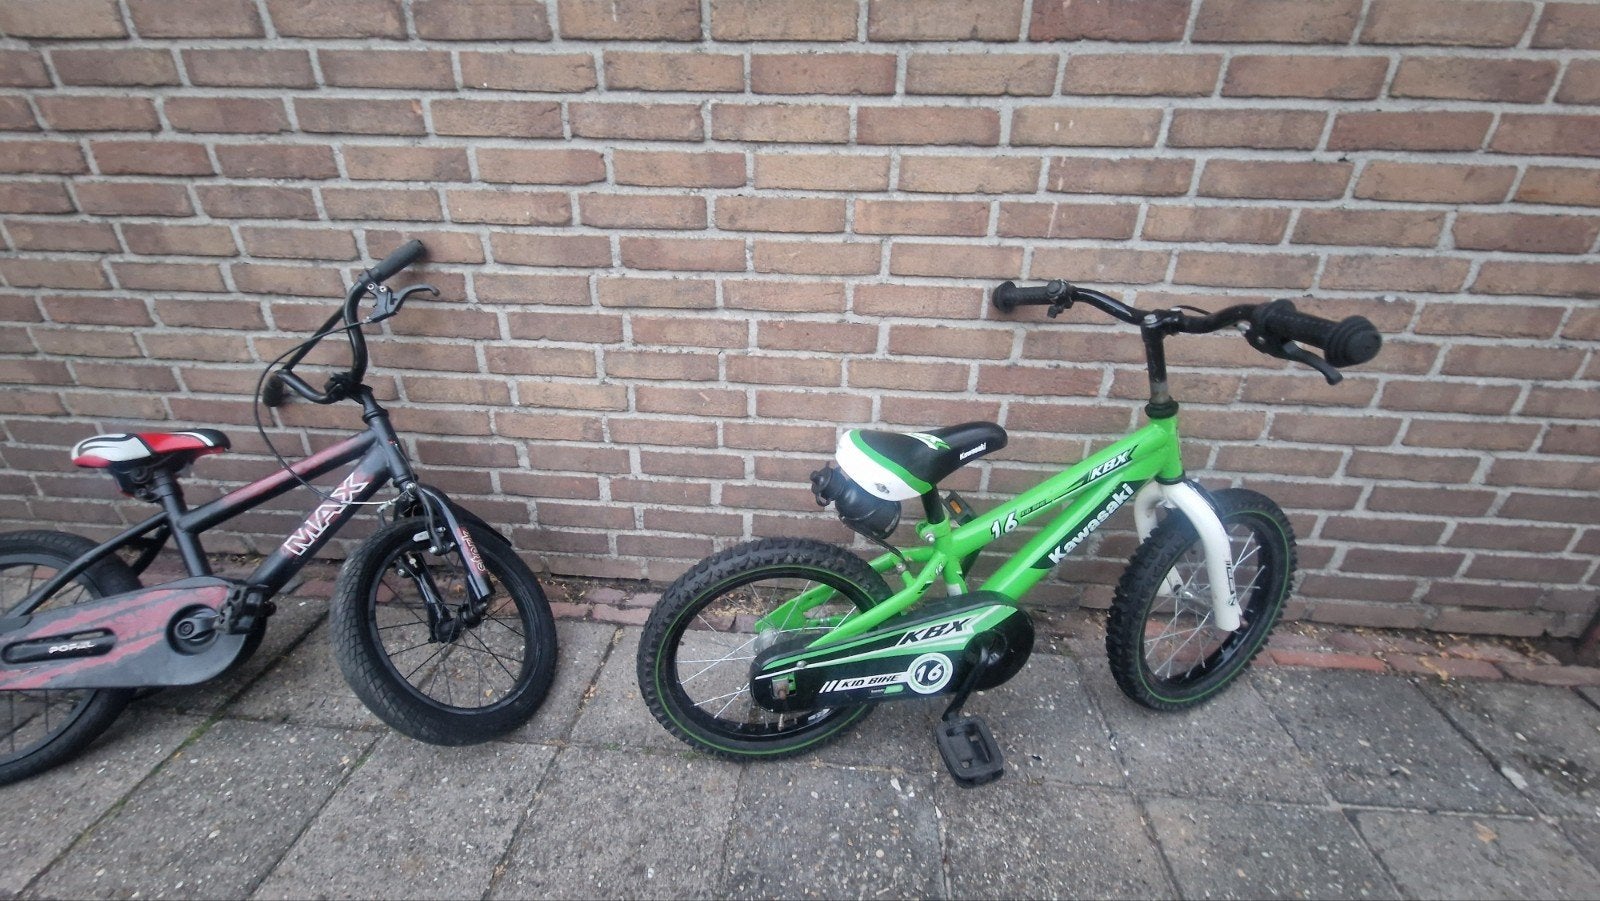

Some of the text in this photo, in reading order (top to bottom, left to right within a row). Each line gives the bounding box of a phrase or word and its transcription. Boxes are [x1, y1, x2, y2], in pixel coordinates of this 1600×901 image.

[1089, 451, 1130, 480] KBX
[283, 472, 369, 556] MAX
[990, 511, 1019, 539] 16
[1048, 482, 1134, 564] Kawasaki
[899, 618, 970, 646] KBX
[841, 674, 899, 688] KID BIKE
[916, 664, 943, 682] 16
